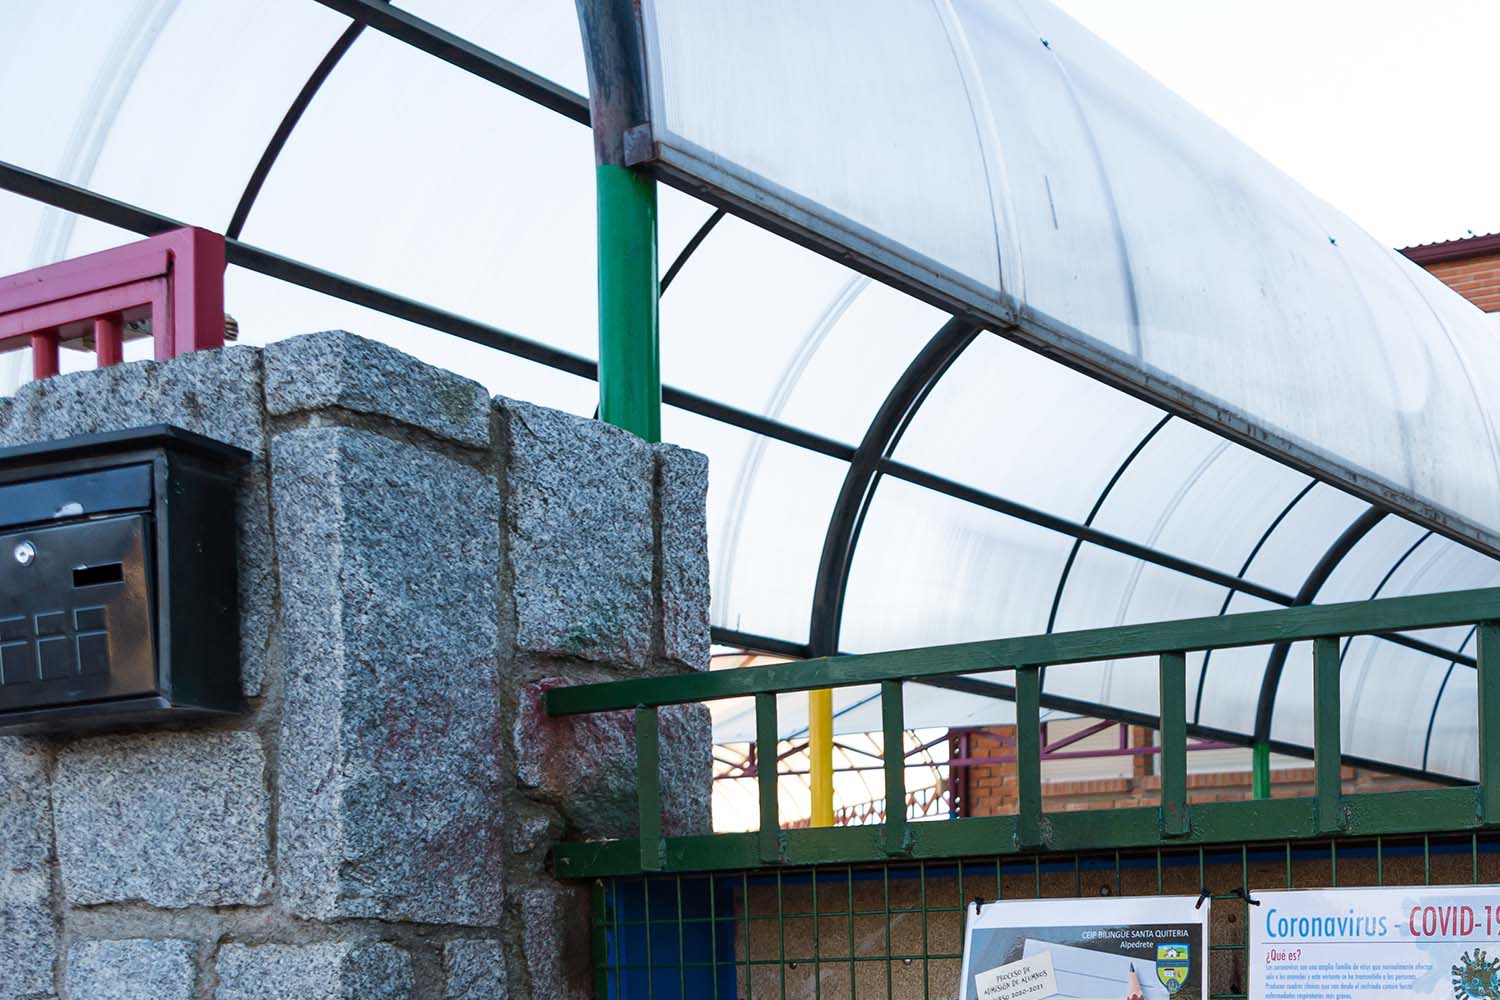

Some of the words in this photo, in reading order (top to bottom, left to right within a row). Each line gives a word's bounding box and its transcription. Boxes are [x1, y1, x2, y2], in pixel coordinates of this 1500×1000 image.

[1266, 907, 1388, 938] Coronavirus
[1081, 931, 1096, 940] CEIP
[1098, 929, 1130, 939] BILINGÜE
[1131, 930, 1154, 938] SANTA
[1155, 929, 1189, 938] QUITERIA
[1120, 941, 1154, 950] Alpedrete
[1266, 948, 1286, 964] ¿Qué
[1288, 948, 1302, 961] es?
[996, 969, 1022, 983] PROCESO
[1022, 966, 1031, 975] DE
[1011, 979, 1019, 987] DE
[1021, 970, 1048, 984] ALUMNOS
[1011, 983, 1044, 998] 2020-2021
